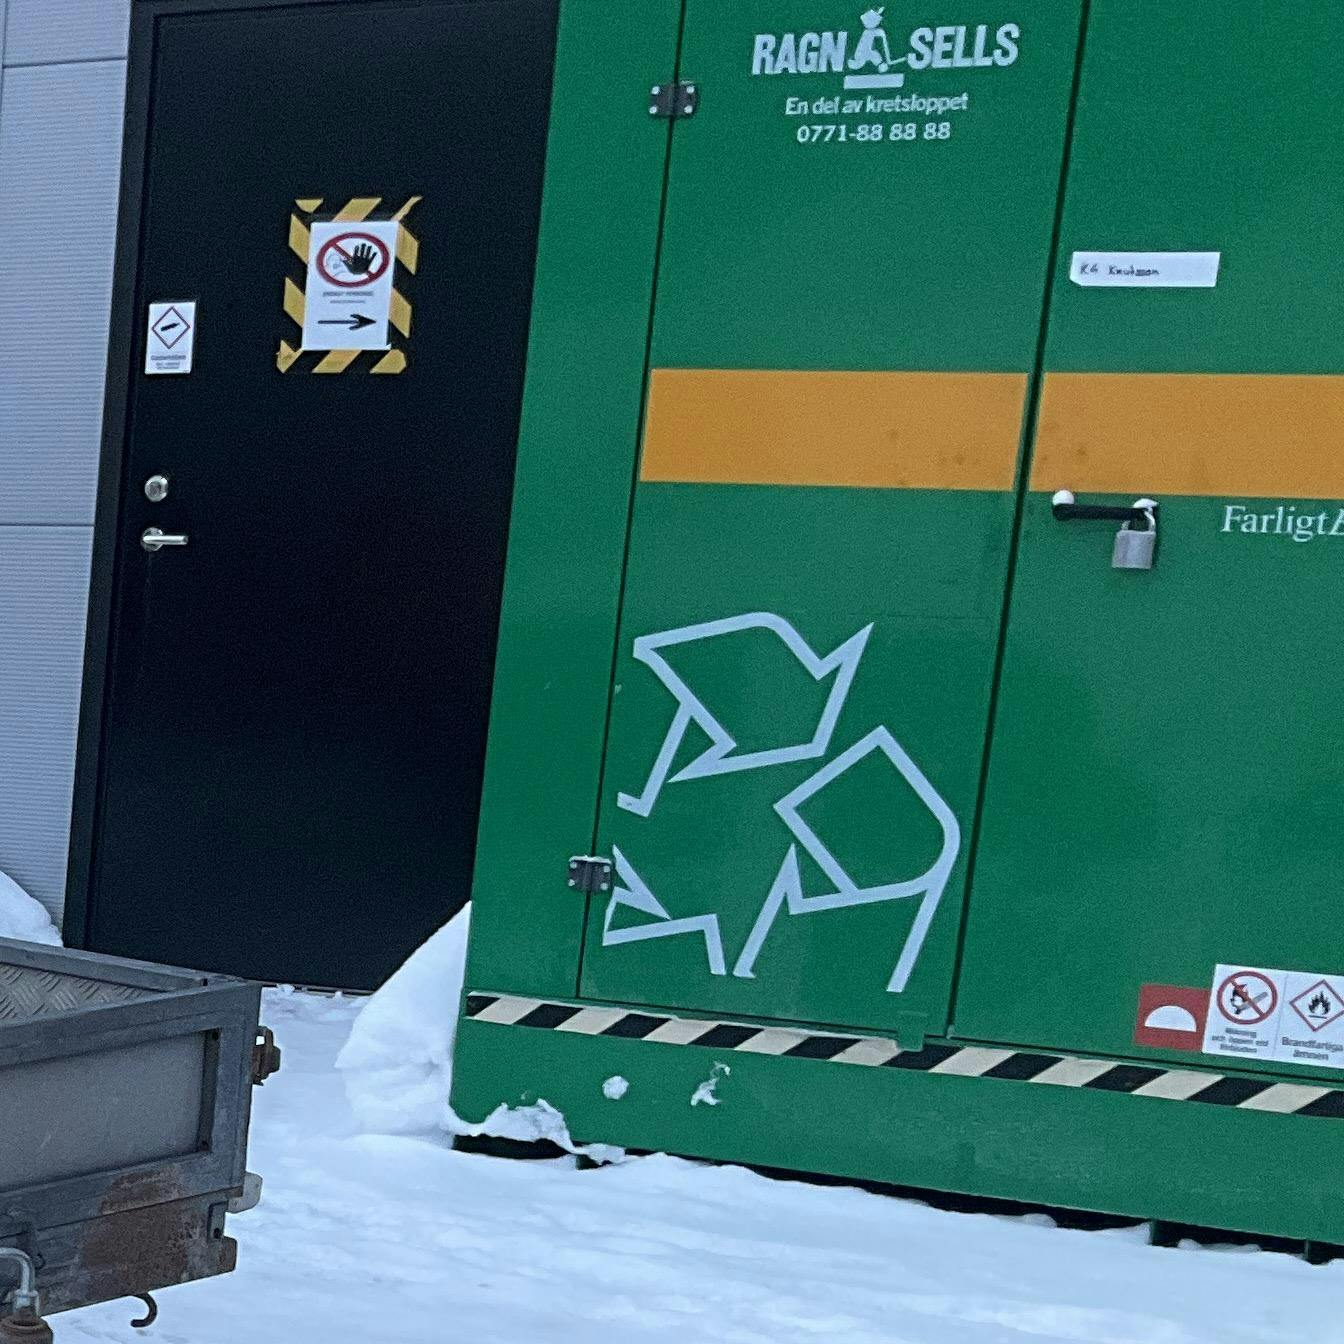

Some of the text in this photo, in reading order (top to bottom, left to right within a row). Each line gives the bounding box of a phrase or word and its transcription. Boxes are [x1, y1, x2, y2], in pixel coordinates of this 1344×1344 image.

[908, 23, 1021, 70] SELLS
[785, 92, 969, 116] En del av kretsloppet
[797, 122, 951, 143] 0771-88 88 88
